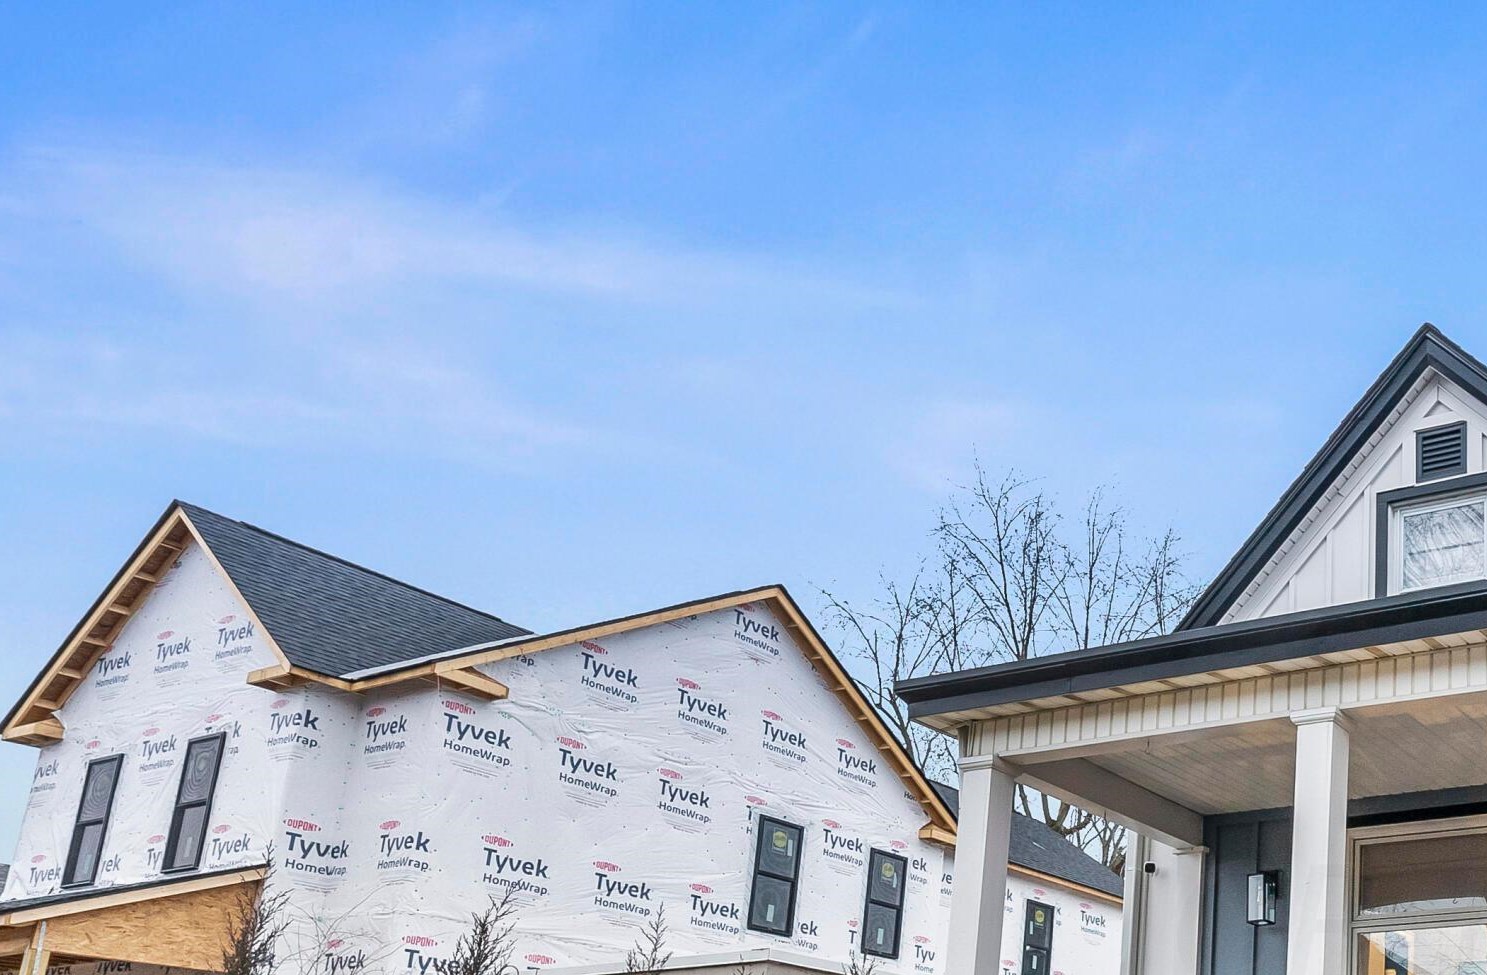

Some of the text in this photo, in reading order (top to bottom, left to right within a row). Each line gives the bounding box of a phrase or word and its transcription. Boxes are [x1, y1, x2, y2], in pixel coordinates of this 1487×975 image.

[218, 621, 254, 648] Tyvek
[734, 609, 779, 642] Tyvek
[156, 636, 191, 662] Tyvek
[734, 630, 779, 656] HomeWrap
[98, 651, 131, 677] Tyvek
[581, 652, 638, 688] Tyvek
[581, 675, 637, 703] HomeWrap
[445, 701, 473, 715] DUPONT
[678, 688, 727, 720] Tyvek
[270, 709, 319, 734] Tyvek
[366, 715, 408, 742] Tyvek
[443, 712, 511, 749] Tyvek
[678, 710, 727, 735] HomeWrap
[762, 719, 806, 749] Tyvek
[142, 735, 177, 760] Tyvek
[267, 733, 319, 748] HomeWrap
[363, 740, 406, 755] HomeWrap
[443, 738, 511, 767] HomeWrap
[559, 736, 584, 750] DUPONT
[762, 741, 806, 763] HomeWrap
[559, 748, 618, 781] Tyvek
[837, 748, 877, 774] Tyvek
[559, 772, 617, 797] HomeWrap
[837, 767, 876, 788] HomeWrap
[659, 779, 710, 808] Tyvek
[658, 801, 710, 823] HomeWrap
[287, 819, 318, 832] DUPONT
[211, 833, 251, 861] Tyvek
[286, 831, 349, 859] Tyvek
[380, 832, 430, 857] Tyvek
[485, 835, 511, 848] DUPONT
[823, 828, 863, 853] Tyvek
[285, 858, 347, 876] HomeWrap
[377, 856, 429, 872] HomeWrap
[483, 847, 549, 878] Tyvek
[823, 848, 863, 867] HomeWrap
[30, 866, 62, 887] Tyvek
[483, 873, 548, 896] HomeWrap
[594, 872, 651, 901] Tyvek
[594, 896, 650, 916] HomeWrap
[691, 894, 740, 920] Tyvek
[691, 917, 740, 935] HomeWrap
[1081, 910, 1106, 928] Tyvek
[406, 935, 434, 947] DUPONT
[325, 950, 365, 975] Tyvek
[404, 949, 461, 975] Tyve
[528, 954, 554, 964] DUPONT
[914, 945, 935, 964] Tyv
